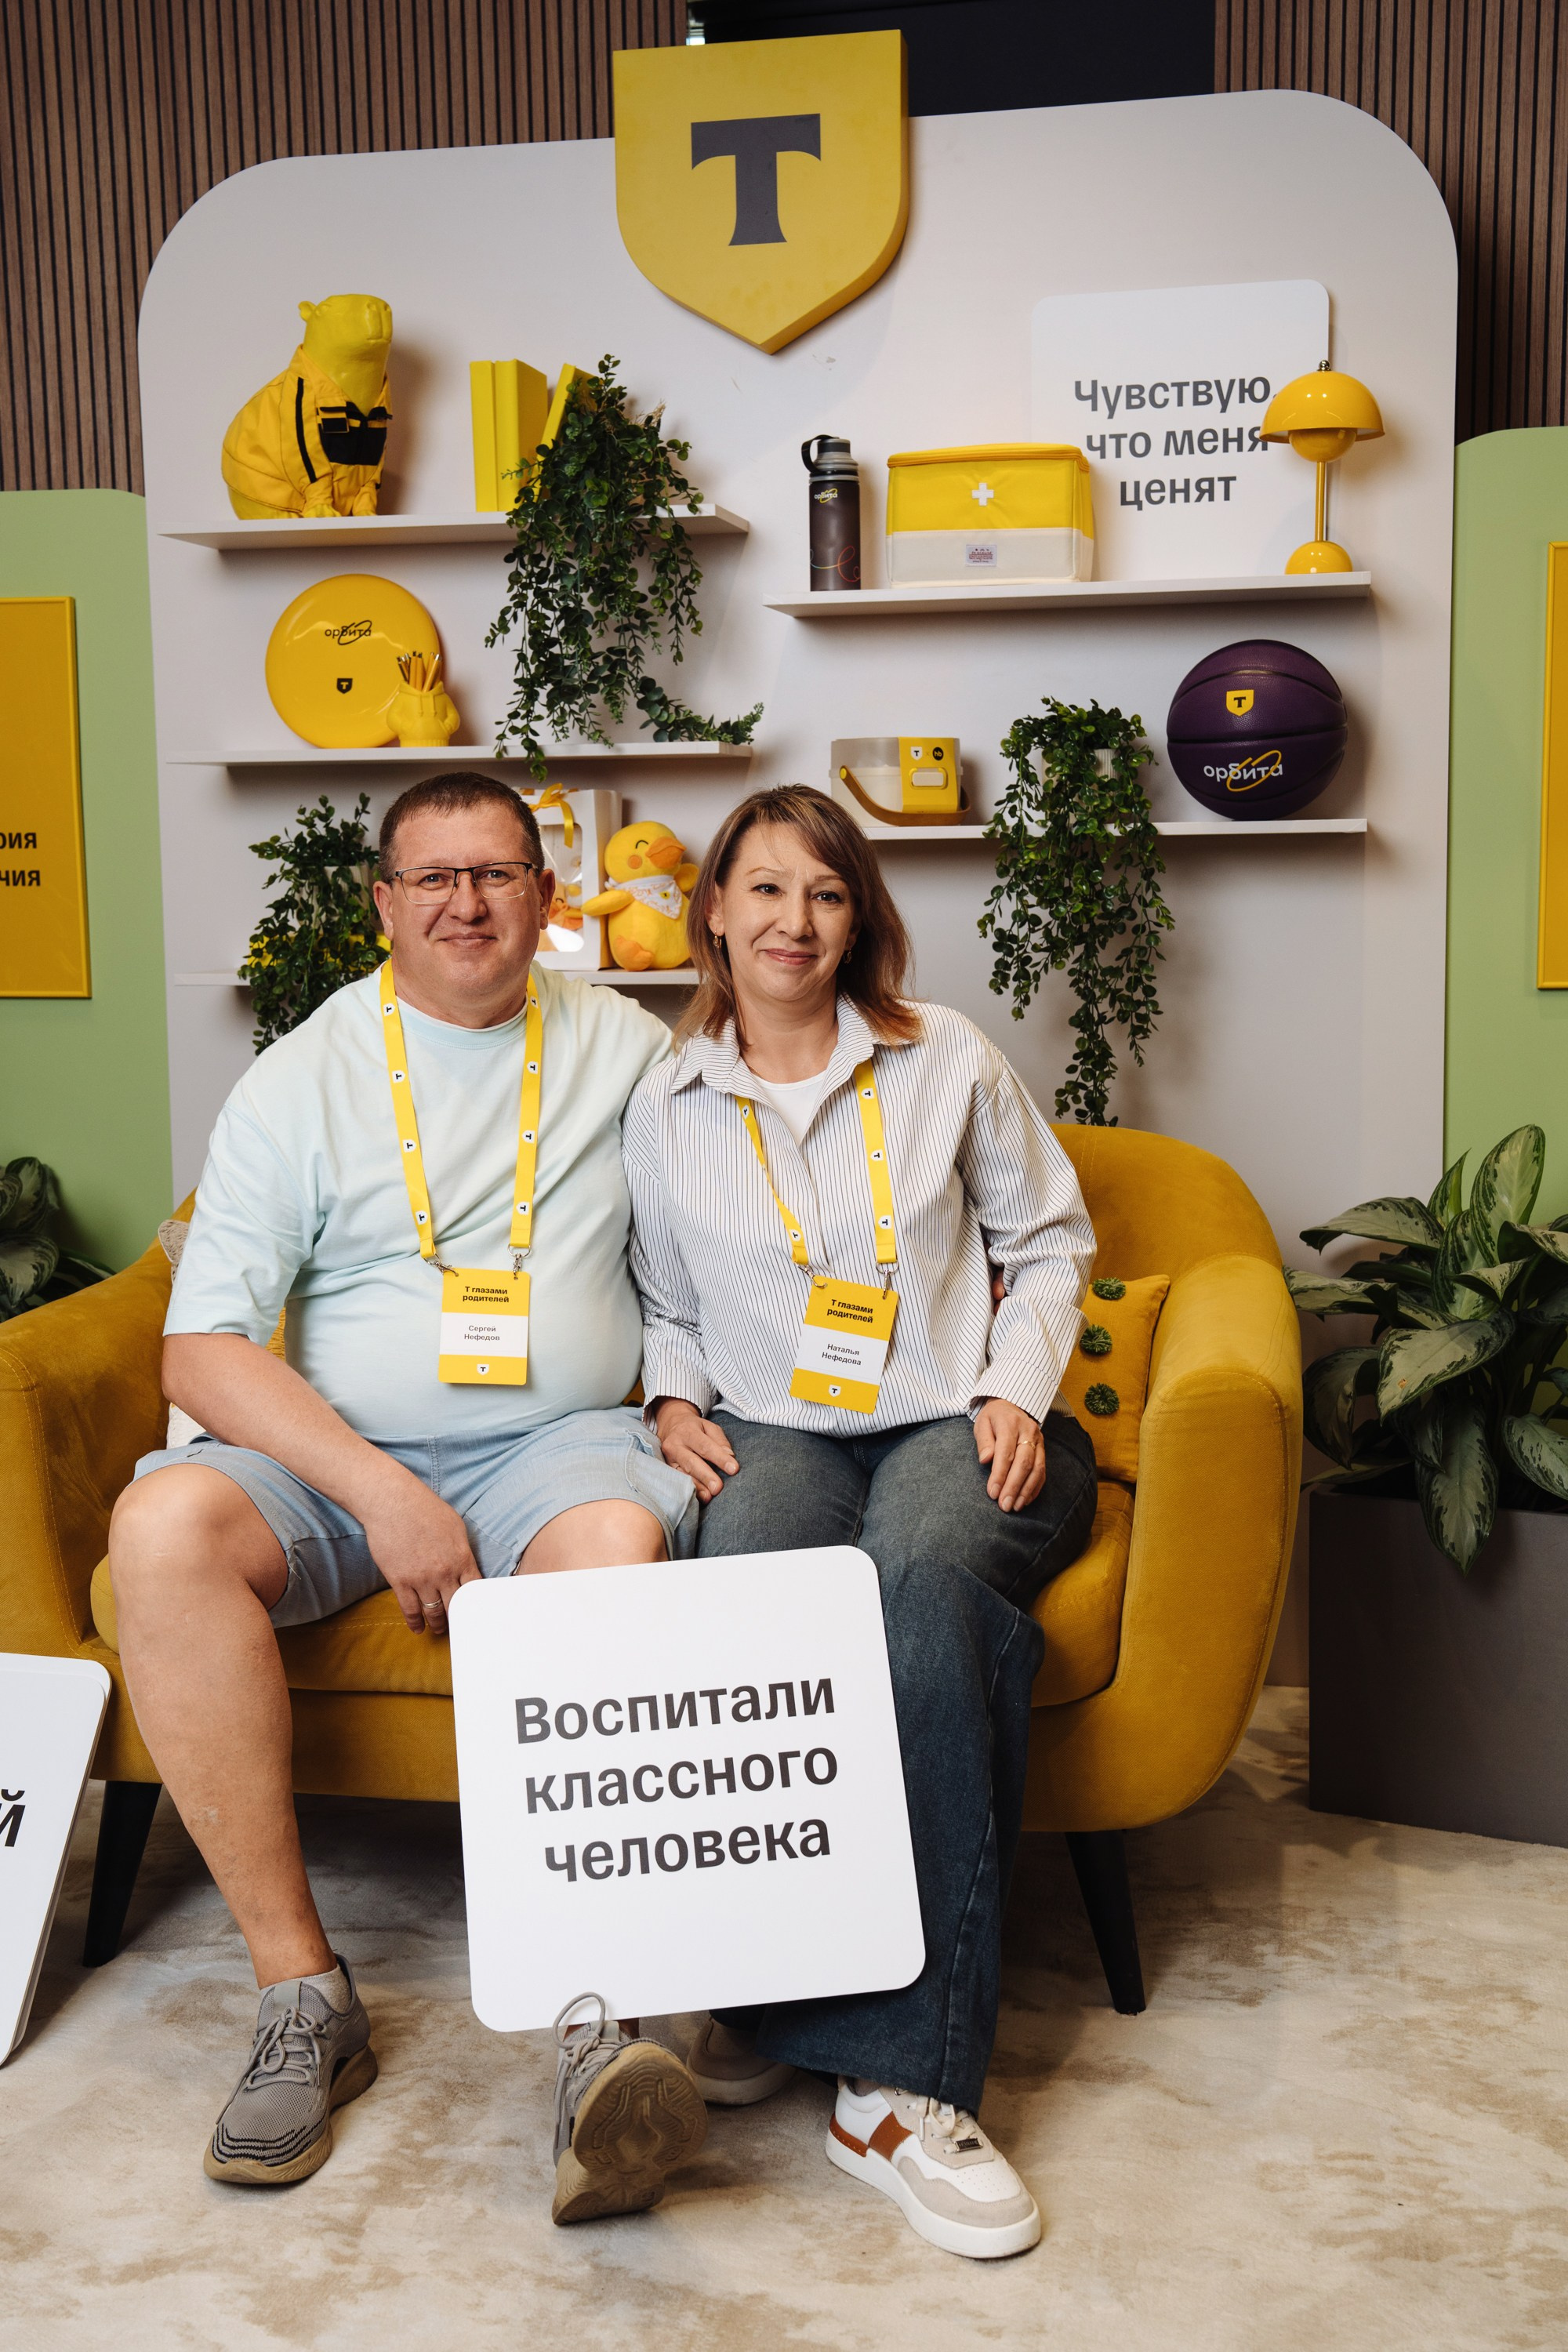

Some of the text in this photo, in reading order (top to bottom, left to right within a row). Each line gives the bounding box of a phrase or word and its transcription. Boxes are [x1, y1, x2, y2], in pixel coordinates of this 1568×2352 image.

[1074, 376, 1276, 419] Чувствую
[1087, 426, 1269, 459] что меня
[1120, 476, 1236, 511] ценят
[462, 1294, 510, 1303] родителей
[837, 1301, 873, 1314] глазами
[826, 1308, 873, 1323] родителей
[463, 1333, 500, 1341] Нефедов
[822, 1352, 862, 1366] Нефедова
[826, 1343, 860, 1356] Наталья
[514, 1678, 835, 1744] Воспитали
[525, 1747, 837, 1814] классного
[544, 1818, 830, 1882] человека
